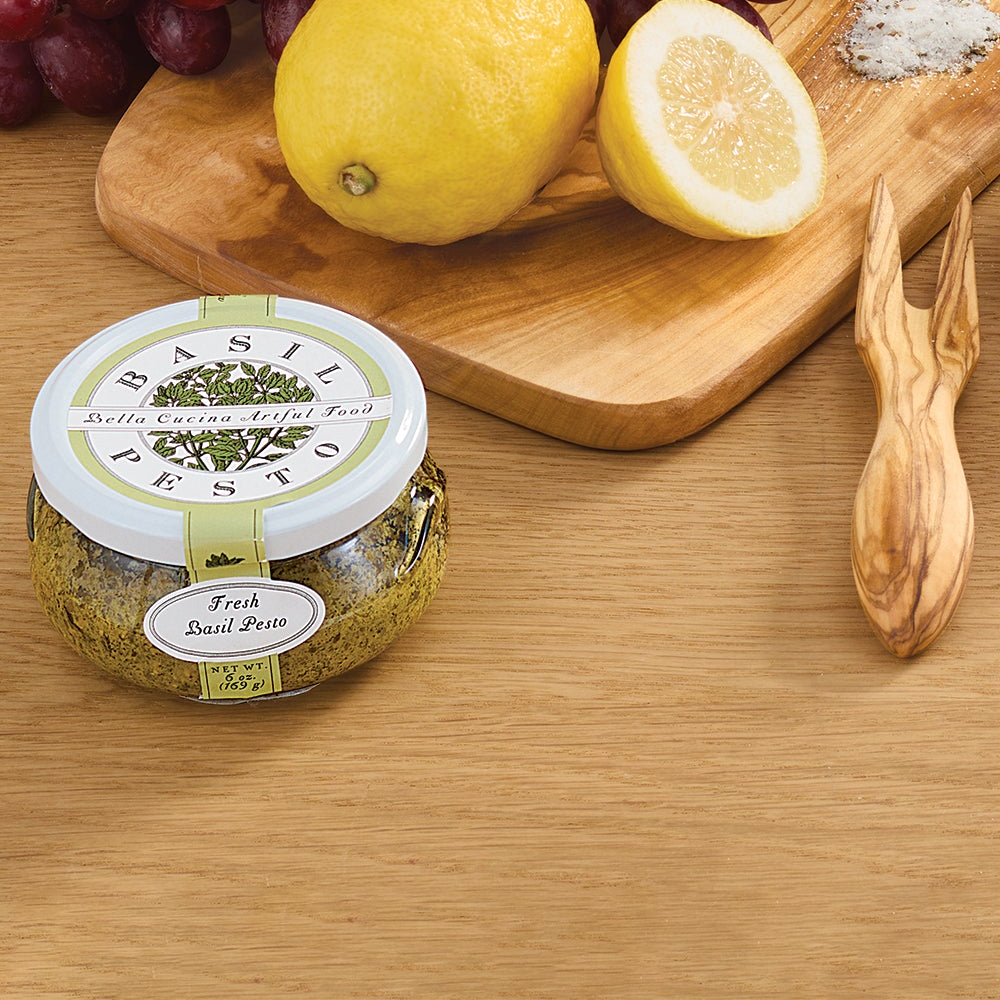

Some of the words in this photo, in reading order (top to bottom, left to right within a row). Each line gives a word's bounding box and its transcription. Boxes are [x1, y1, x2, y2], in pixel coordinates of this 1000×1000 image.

[114, 334, 344, 393] BASIL
[82, 411, 147, 425] Bella
[155, 411, 232, 425] Cucina
[239, 406, 312, 424] Artful
[320, 402, 374, 418] Food
[109, 442, 340, 498] PESTO
[207, 592, 260, 612] Fresh
[184, 617, 234, 637] Basil
[238, 615, 288, 632] Pesto
[210, 664, 239, 674] NET
[243, 661, 268, 671] WT.
[225, 672, 234, 682] 6
[238, 673, 257, 681] oz.
[218, 680, 248, 691] (169
[251, 679, 266, 693] g)
